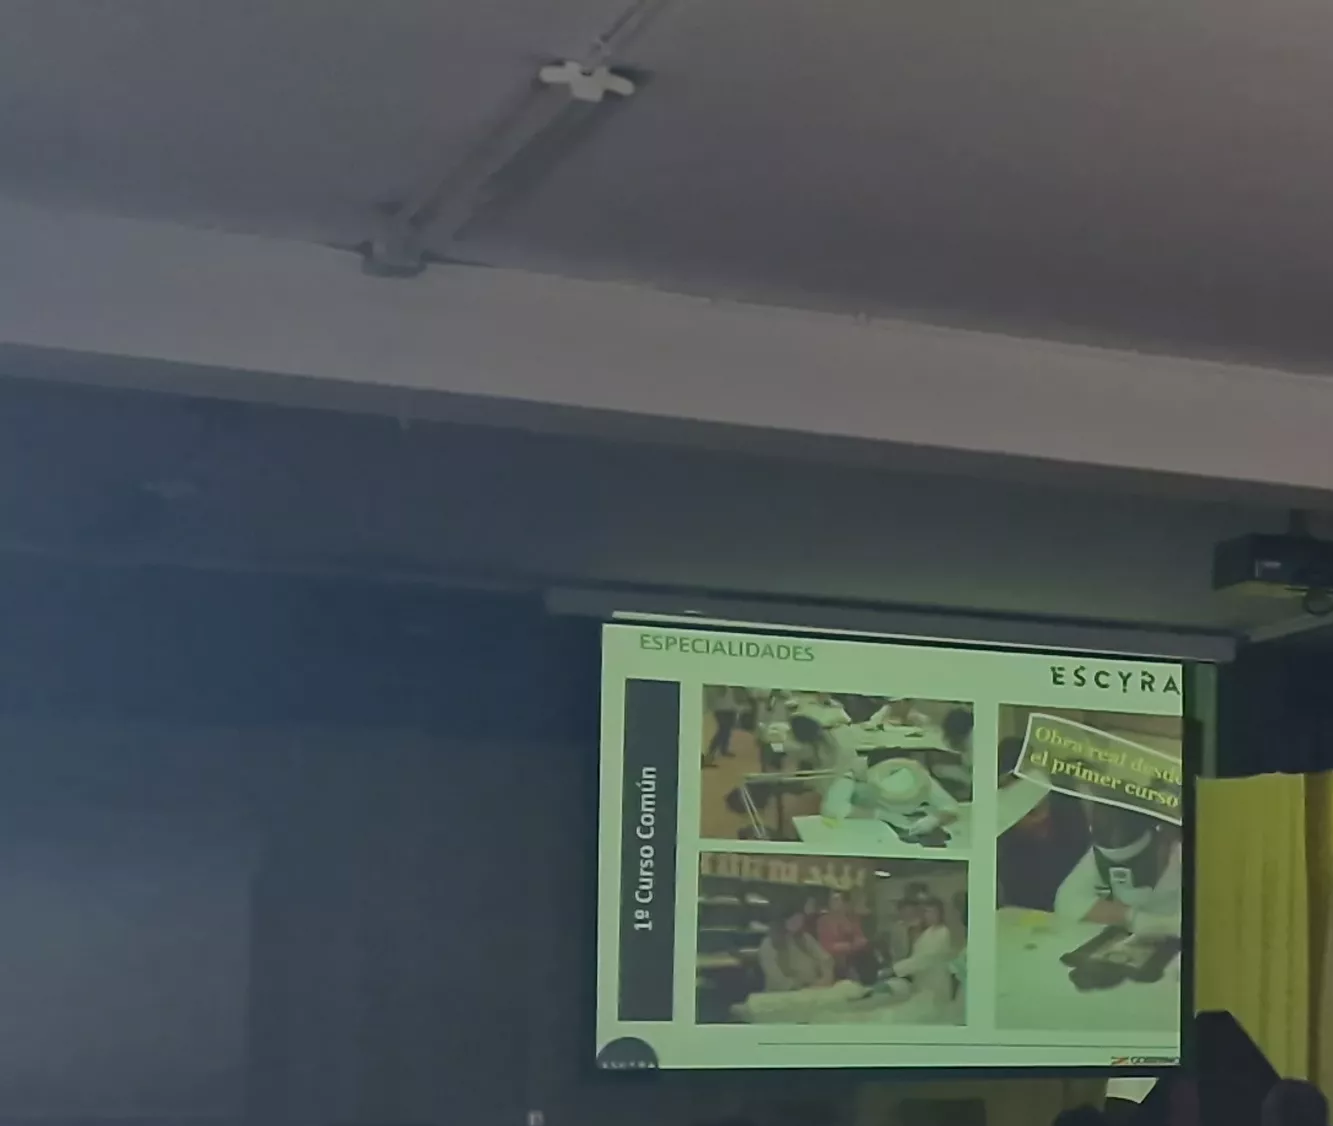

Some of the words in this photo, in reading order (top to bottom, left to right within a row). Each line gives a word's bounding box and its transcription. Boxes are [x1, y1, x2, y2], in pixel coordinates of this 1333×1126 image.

[639, 633, 816, 662] ESPECIALIDADES
[1050, 665, 1181, 695] ESCYRA
[1034, 727, 1081, 754] Obra
[1030, 750, 1049, 768] el
[1051, 758, 1122, 790] primer
[1124, 783, 1179, 808] curso
[635, 766, 657, 839] Común
[634, 845, 654, 904] Curso
[633, 907, 653, 931] 1º
